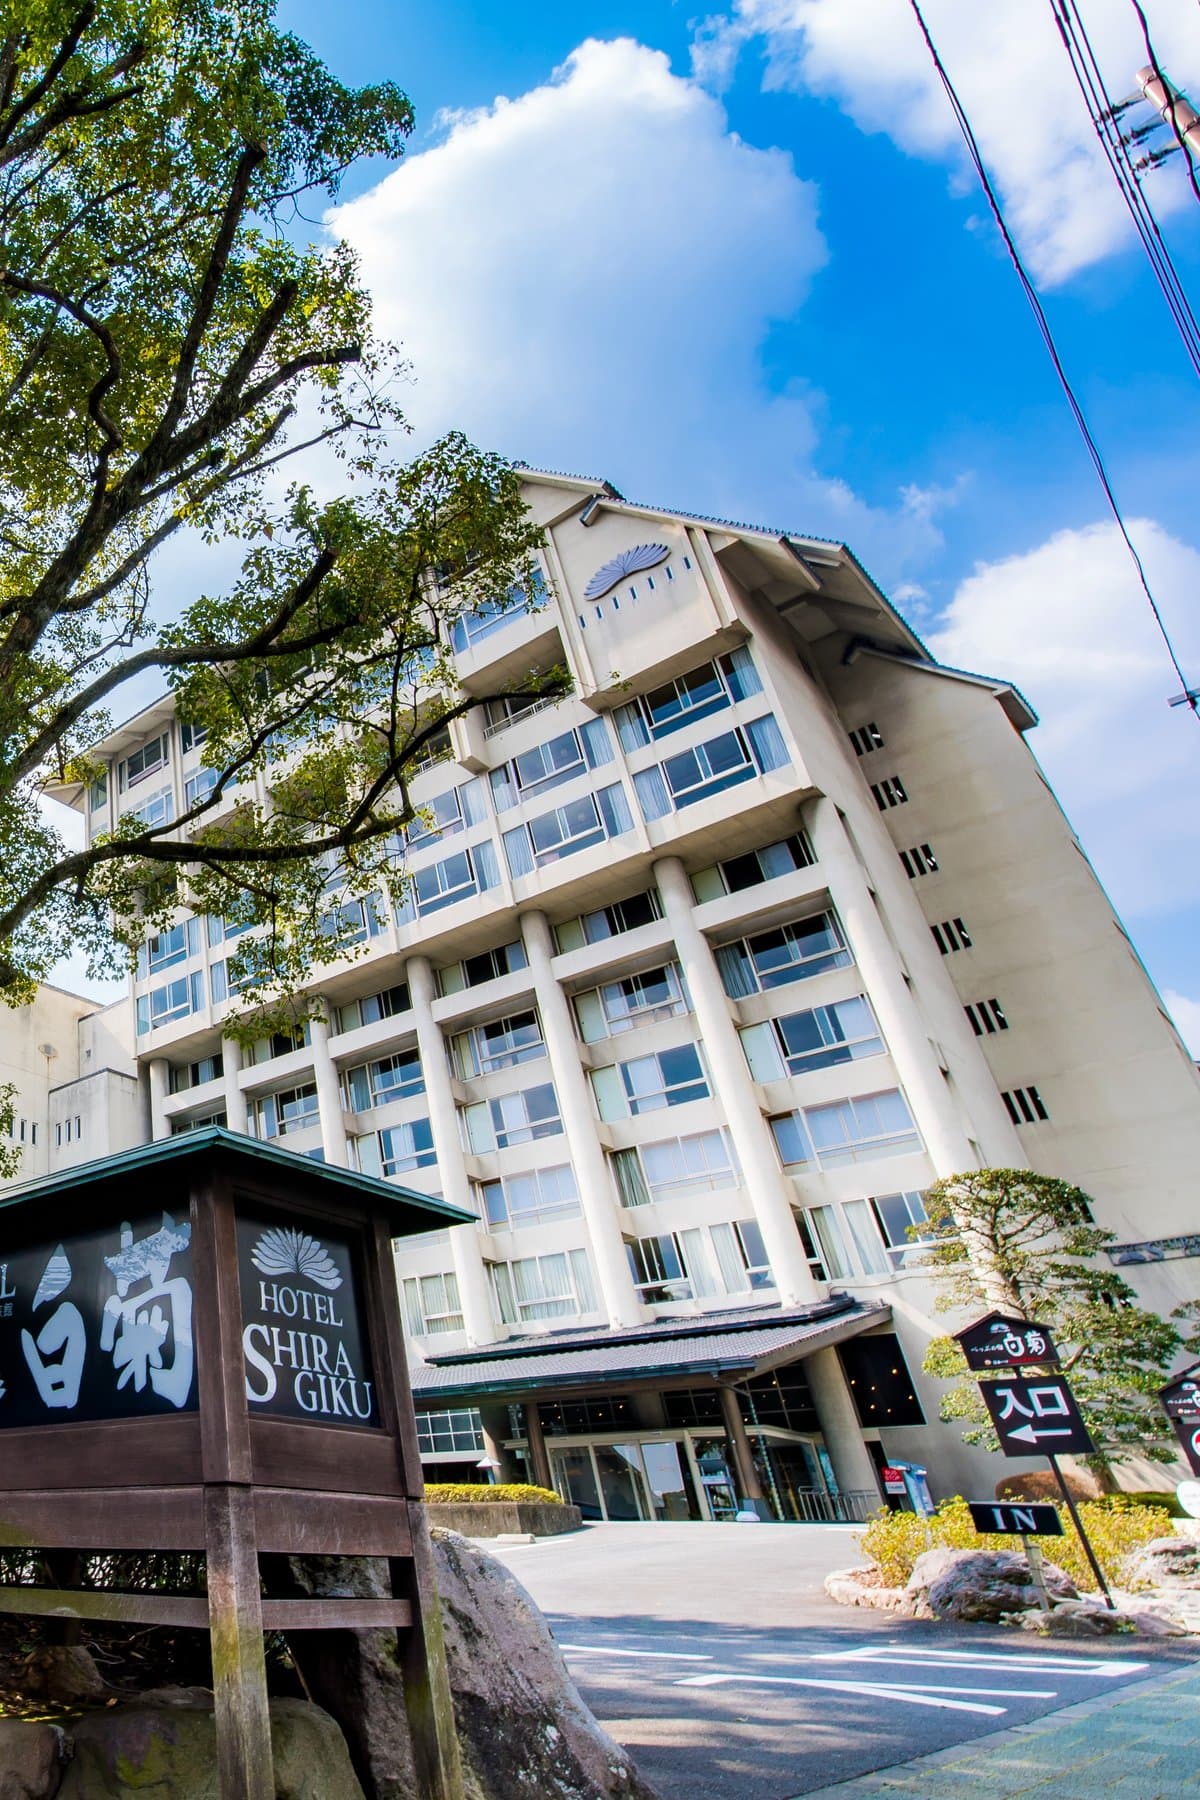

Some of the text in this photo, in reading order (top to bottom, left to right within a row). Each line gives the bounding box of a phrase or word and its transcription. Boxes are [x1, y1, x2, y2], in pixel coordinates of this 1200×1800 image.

[21, 1210, 193, 1408] 白菊
[259, 1280, 344, 1327] HOTEL
[242, 1323, 356, 1402] SHIRA
[1003, 1330, 1046, 1357] 白菊
[294, 1371, 372, 1419] GIKU
[995, 1386, 1070, 1420] 入口
[992, 1508, 1037, 1531] IN
